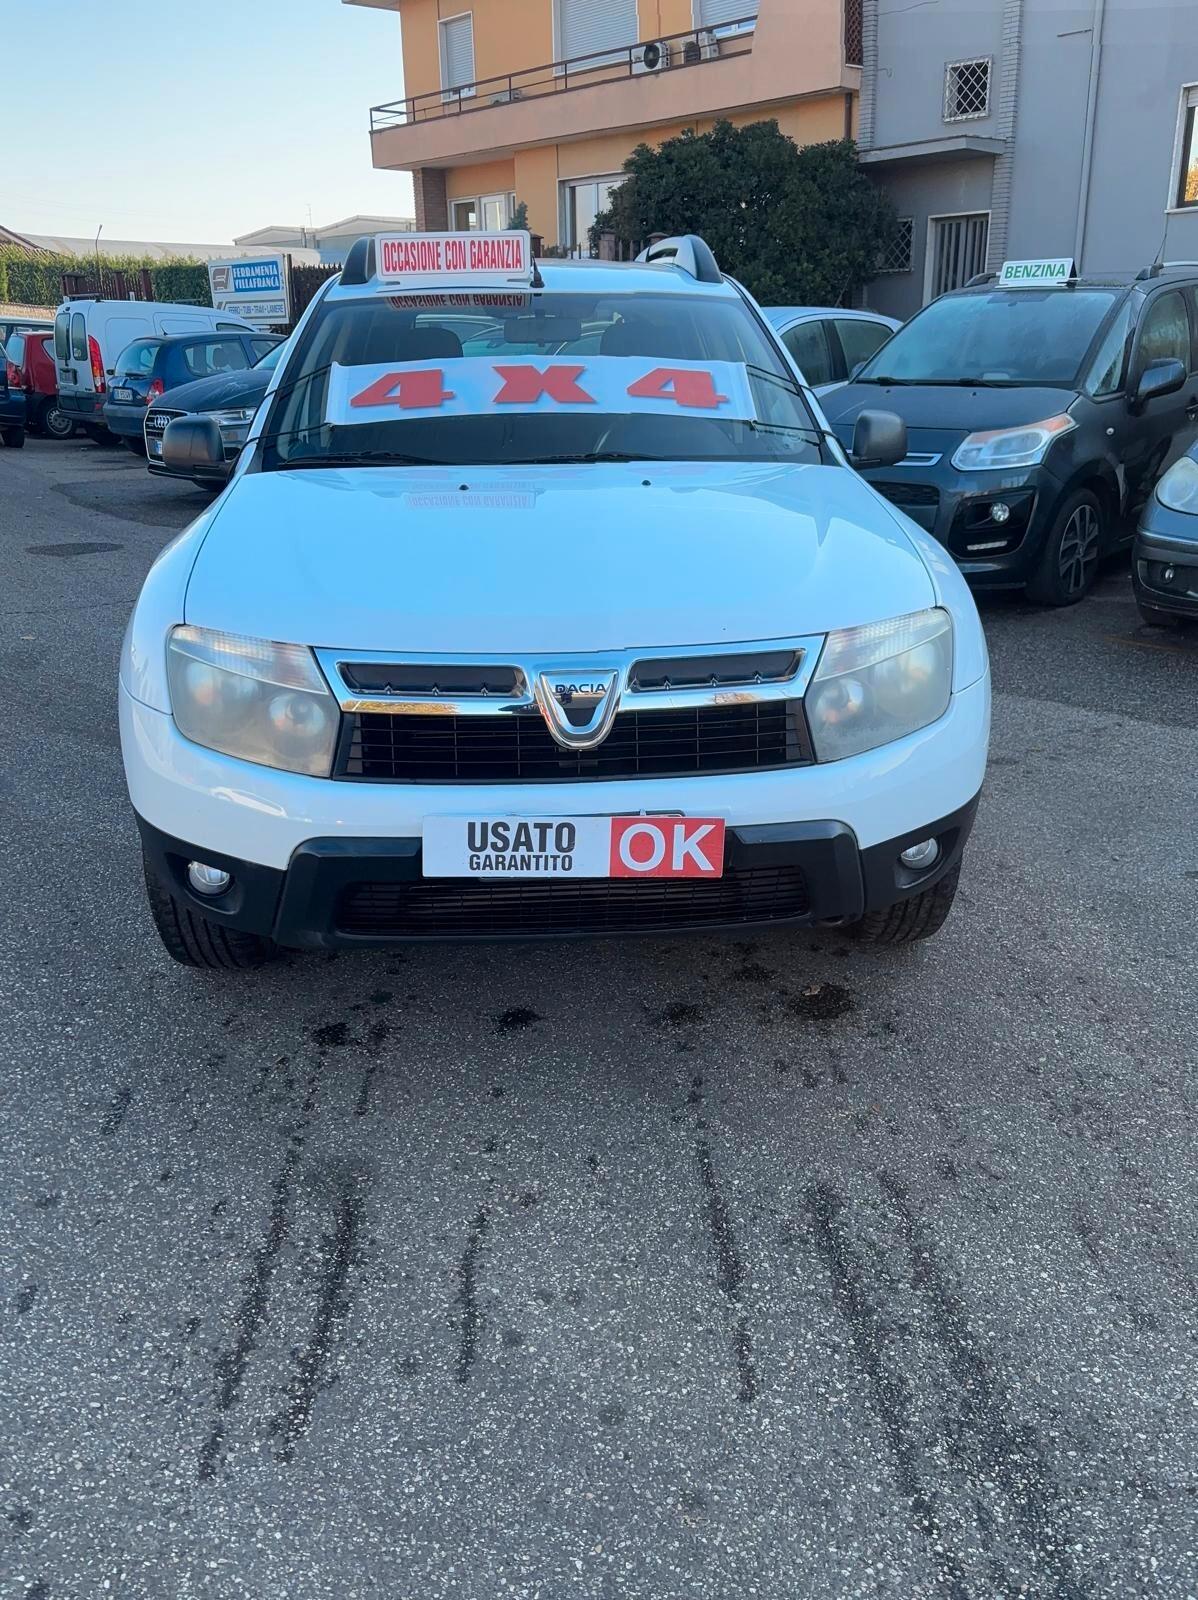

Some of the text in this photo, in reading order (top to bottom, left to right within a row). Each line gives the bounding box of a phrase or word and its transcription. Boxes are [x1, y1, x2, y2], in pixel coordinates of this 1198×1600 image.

[383, 239, 523, 272] OCCASIONE CON GARANZIA
[232, 264, 278, 278] FERRAMENTA
[1004, 263, 1067, 279] BENZINA
[234, 276, 279, 289] VILLAFRANCA
[350, 365, 730, 408] 4 X 4
[555, 683, 607, 693] DACIA
[467, 822, 576, 854] USATO
[619, 823, 717, 872] OK
[469, 854, 573, 872] GARANTITO
